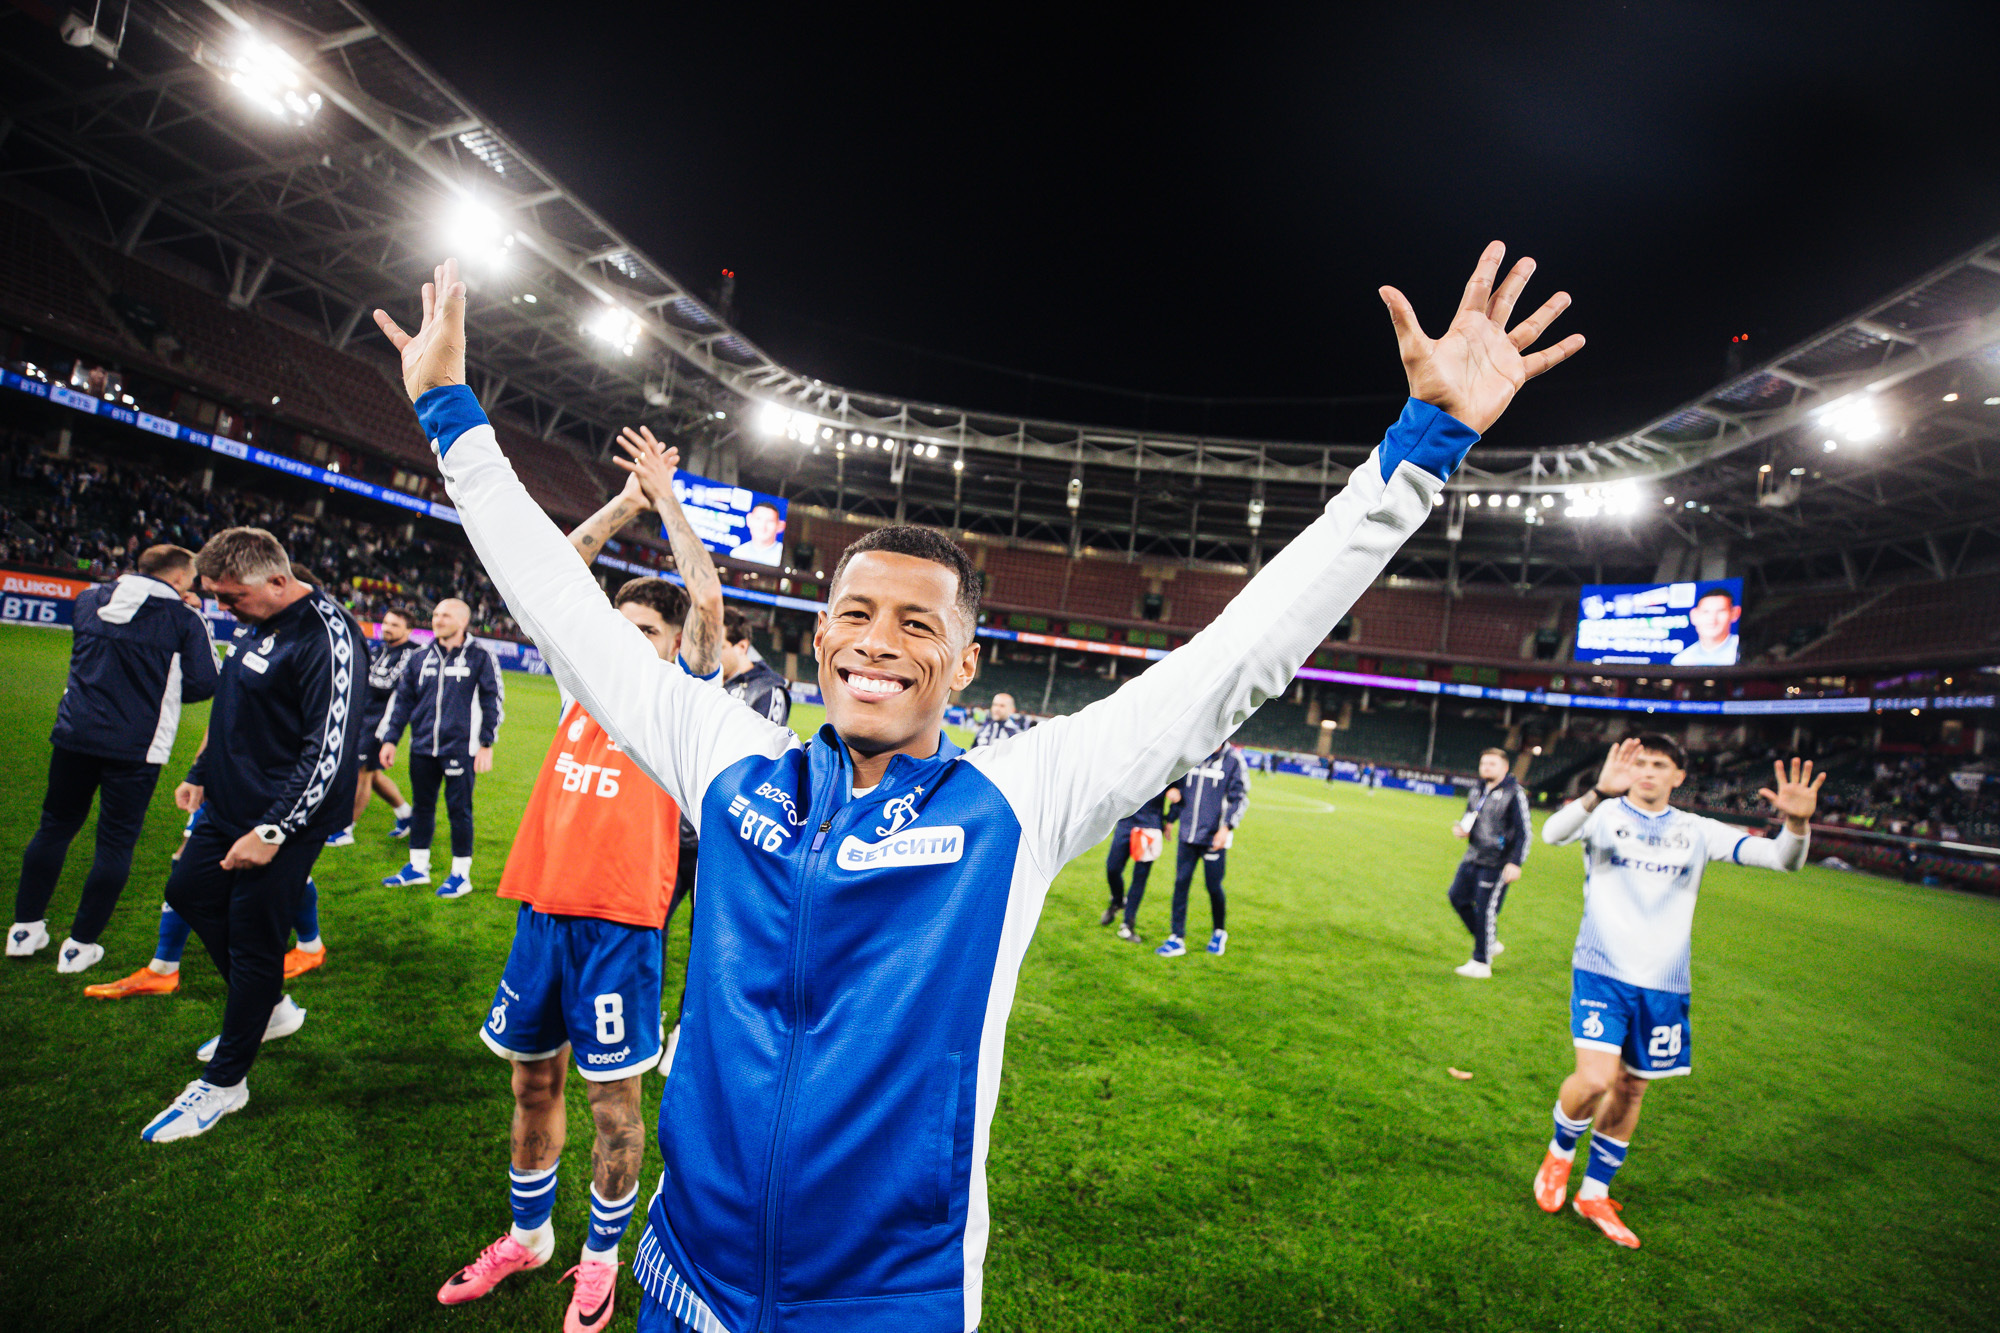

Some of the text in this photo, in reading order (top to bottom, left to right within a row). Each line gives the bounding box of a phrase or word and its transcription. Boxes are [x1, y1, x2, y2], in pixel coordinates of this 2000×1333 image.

[20, 378, 47, 397] ВТБ
[2, 596, 58, 623] ВТБ
[754, 781, 798, 826] BOSCO
[740, 808, 792, 853] ВТБ
[846, 836, 958, 863] БЕТСИТИ
[594, 992, 625, 1044] 8
[1648, 1023, 1682, 1058] 28
[587, 1050, 626, 1065] BOSCO
